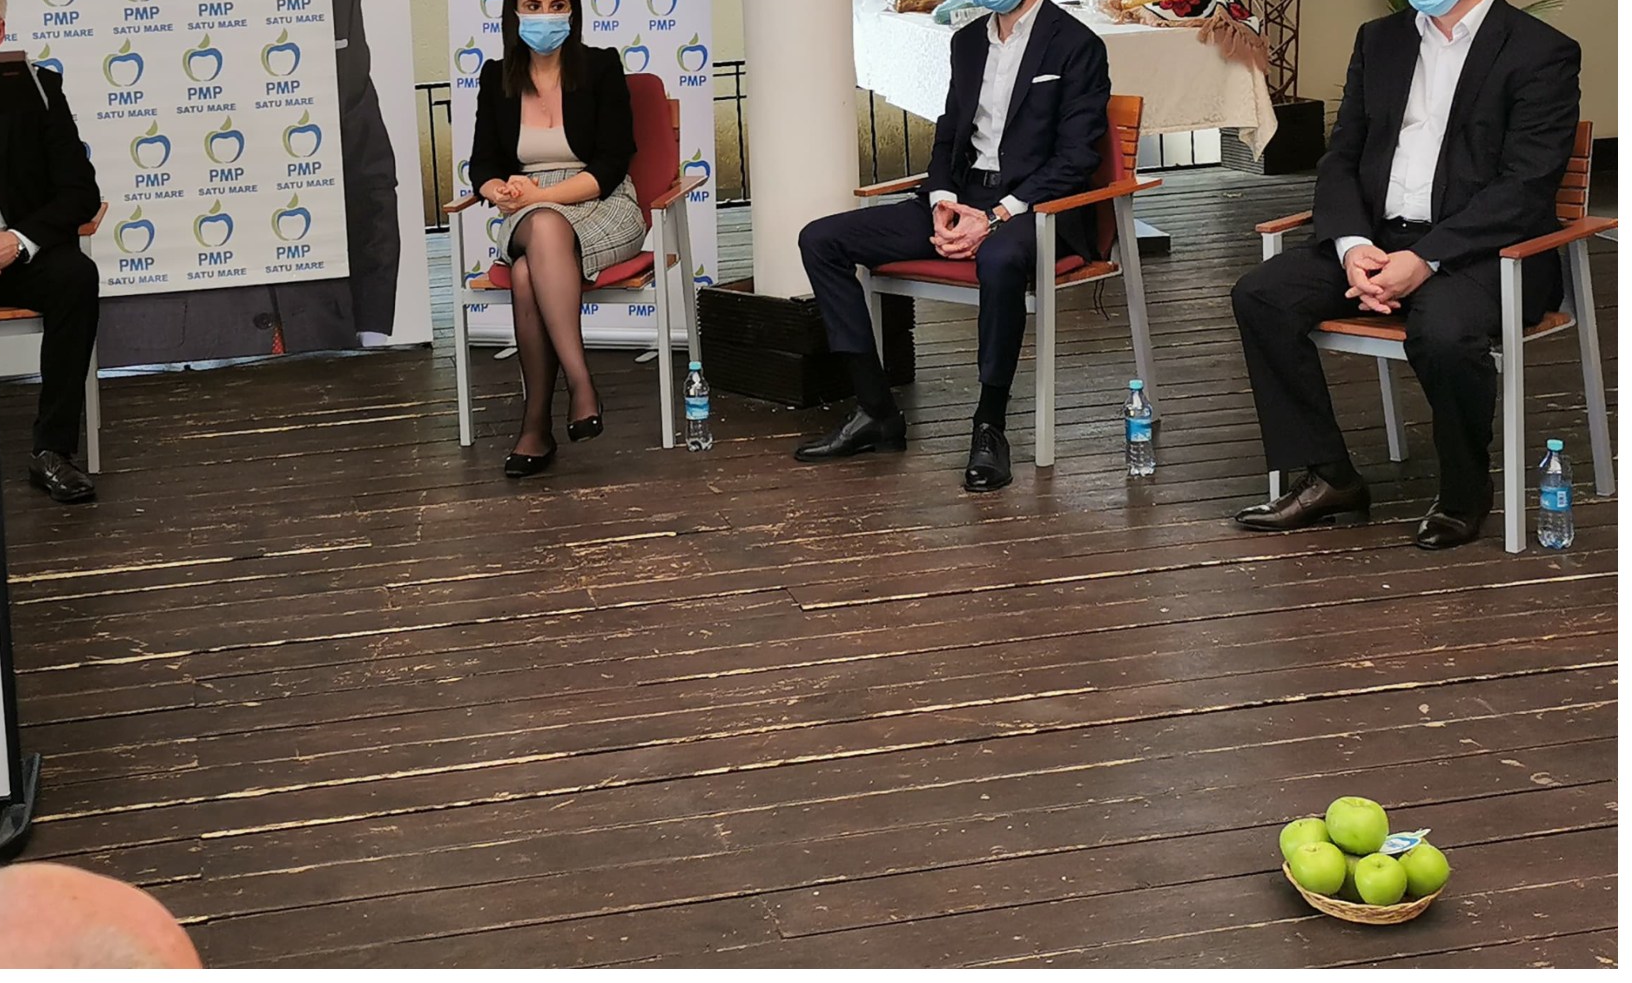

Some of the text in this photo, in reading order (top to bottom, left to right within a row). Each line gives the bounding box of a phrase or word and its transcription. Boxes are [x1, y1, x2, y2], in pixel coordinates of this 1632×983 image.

[123, 6, 160, 22] PMP
[198, 1, 234, 17] PMP
[43, 10, 80, 27] PMP
[187, 18, 248, 31] SATU MARE
[592, 20, 620, 32] PMP
[649, 19, 676, 31] PMP
[31, 28, 94, 40] SATU MARE
[265, 79, 301, 96] PMP
[679, 75, 707, 87] PMP
[107, 90, 144, 106] PMP
[187, 85, 223, 101] PMP
[254, 96, 314, 110] SATU MARE
[96, 108, 158, 120] SATU MARE
[209, 167, 245, 183] PMP
[287, 161, 322, 178] PMP
[135, 172, 171, 189] PMP
[198, 184, 258, 197] SATU MARE
[197, 250, 234, 267] PMP
[276, 244, 311, 260] PMP
[118, 256, 155, 273] PMP
[264, 260, 325, 274] SATU MARE
[107, 273, 169, 286] SATU MARE
[628, 304, 656, 317] PMP
